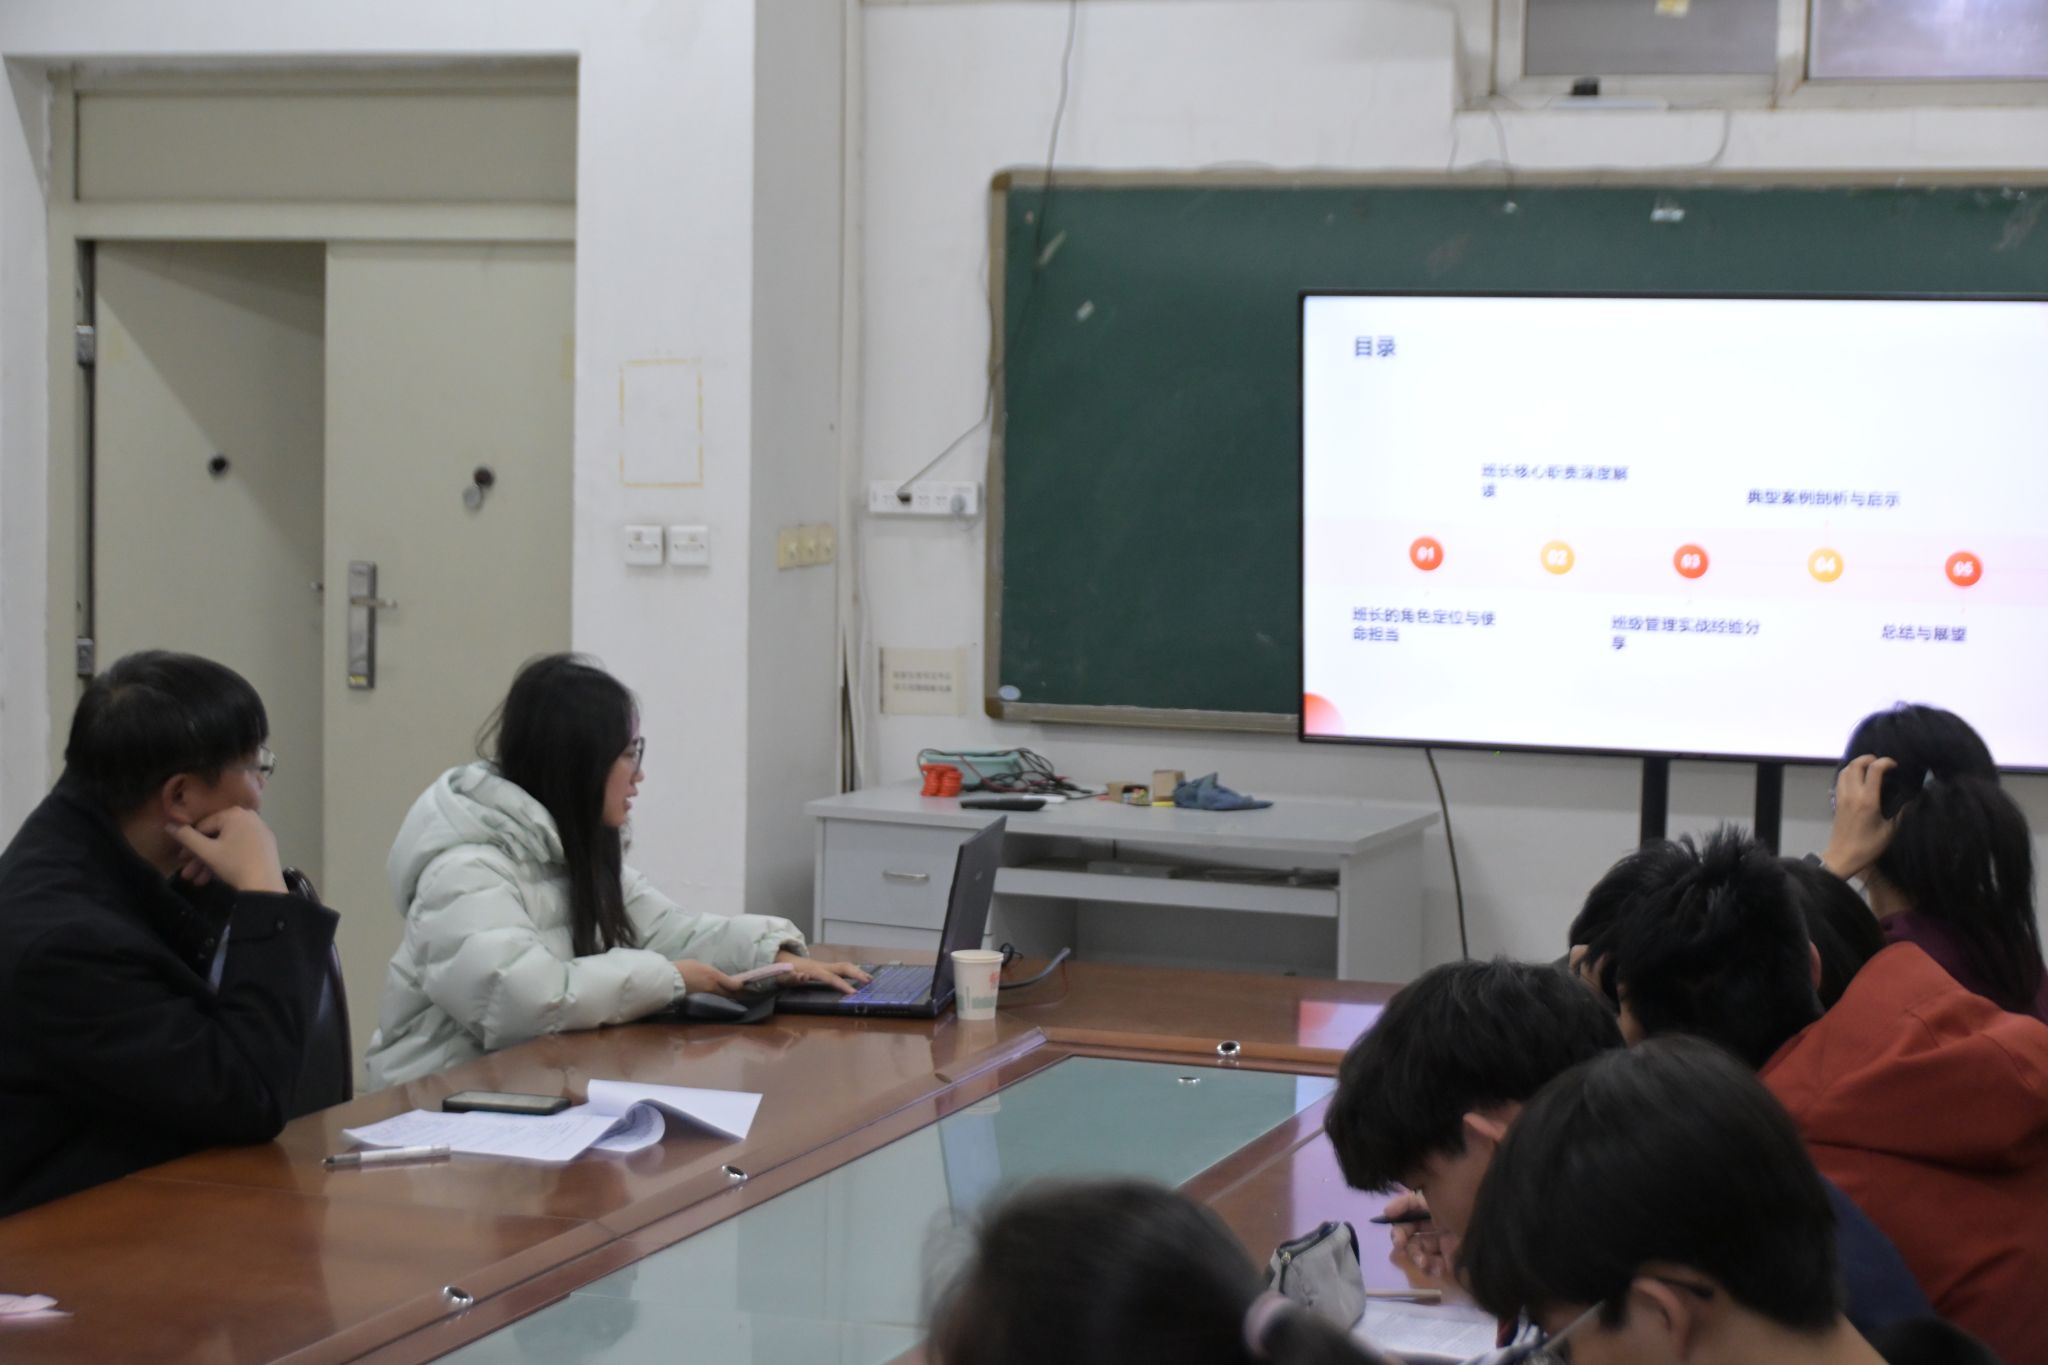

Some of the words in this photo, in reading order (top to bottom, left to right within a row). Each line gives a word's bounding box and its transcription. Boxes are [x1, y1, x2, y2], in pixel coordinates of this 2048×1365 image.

[1355, 336, 1396, 357] 目录
[1748, 488, 1900, 507] 典型案例剖析与启示
[1416, 546, 1435, 562] 01
[1547, 549, 1568, 566] 02
[1680, 553, 1701, 570] 03
[1814, 556, 1836, 574] 04
[1952, 560, 1974, 578] 05
[1352, 606, 1496, 626] 班长的角色定位与使
[1353, 626, 1399, 642] 命担当
[1612, 616, 1760, 635] 班级管理实战经验分
[1882, 623, 1967, 641] 总结与展望
